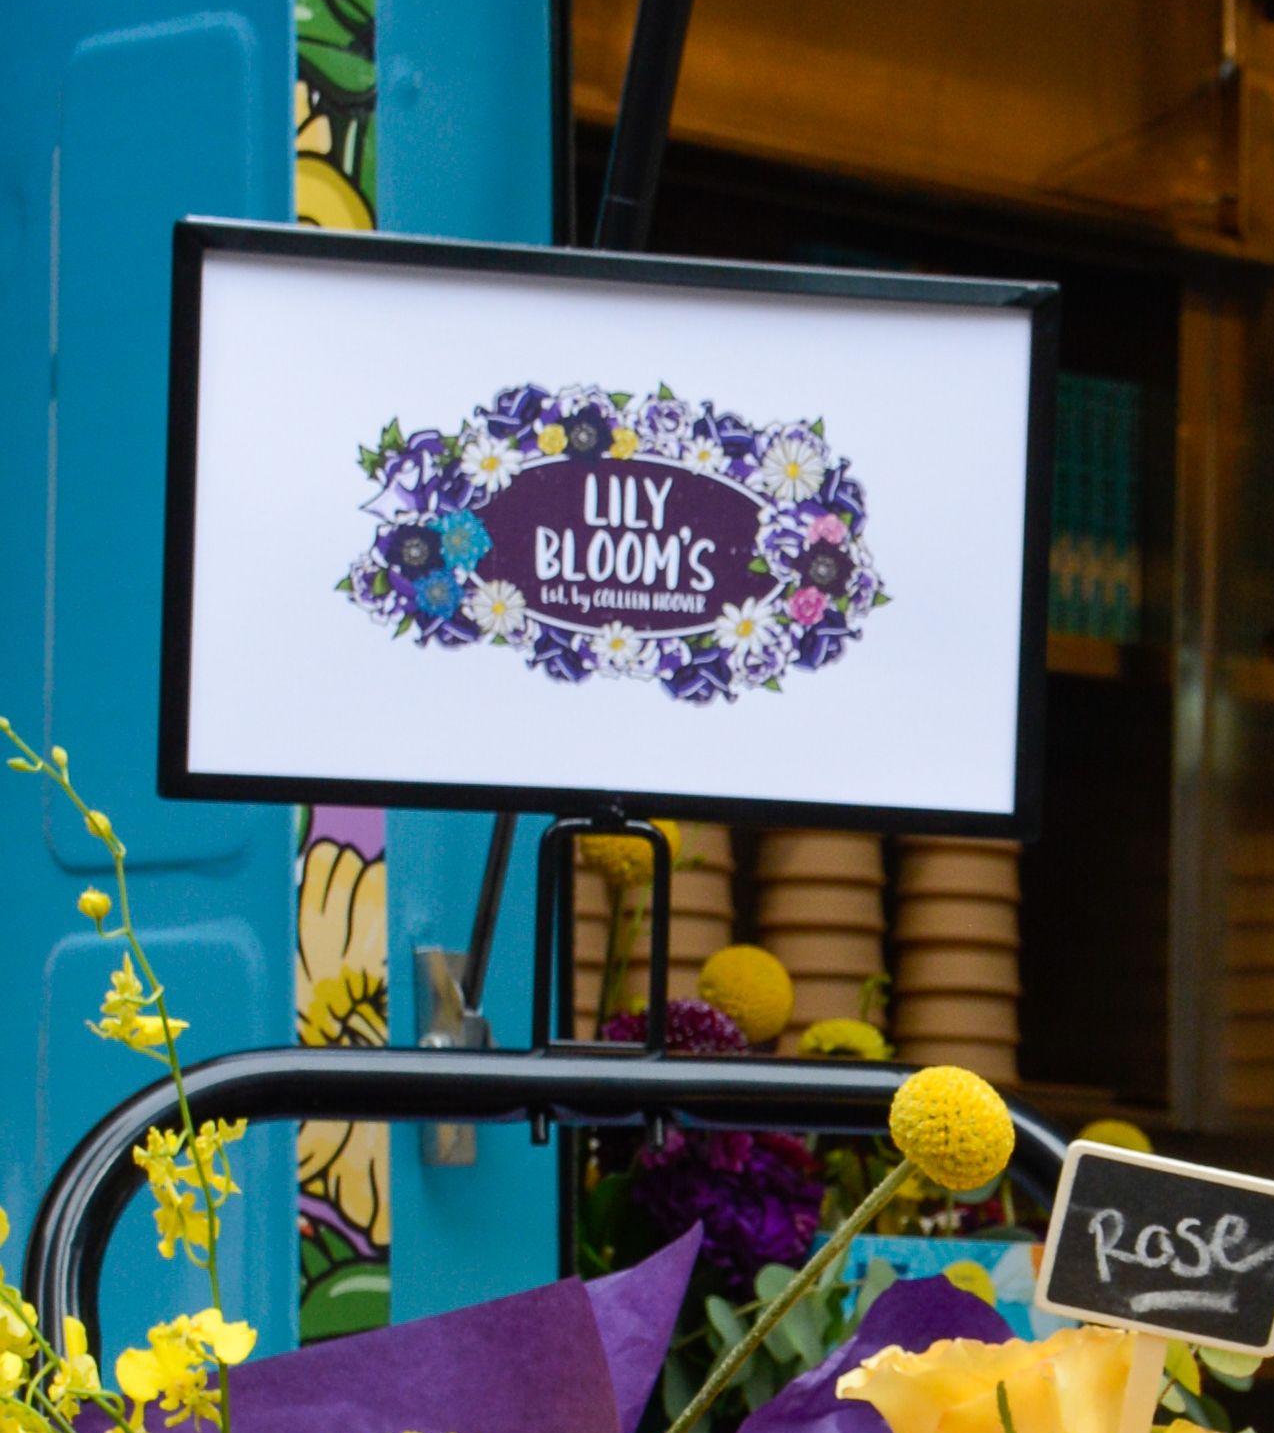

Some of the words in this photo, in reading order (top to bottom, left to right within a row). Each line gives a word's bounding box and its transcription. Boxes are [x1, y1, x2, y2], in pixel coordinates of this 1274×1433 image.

[584, 472, 673, 531] LILY
[535, 525, 716, 592] BLOOM'S
[571, 583, 591, 614] by
[593, 588, 650, 611] COLLEEN
[652, 591, 706, 614] HOOVER
